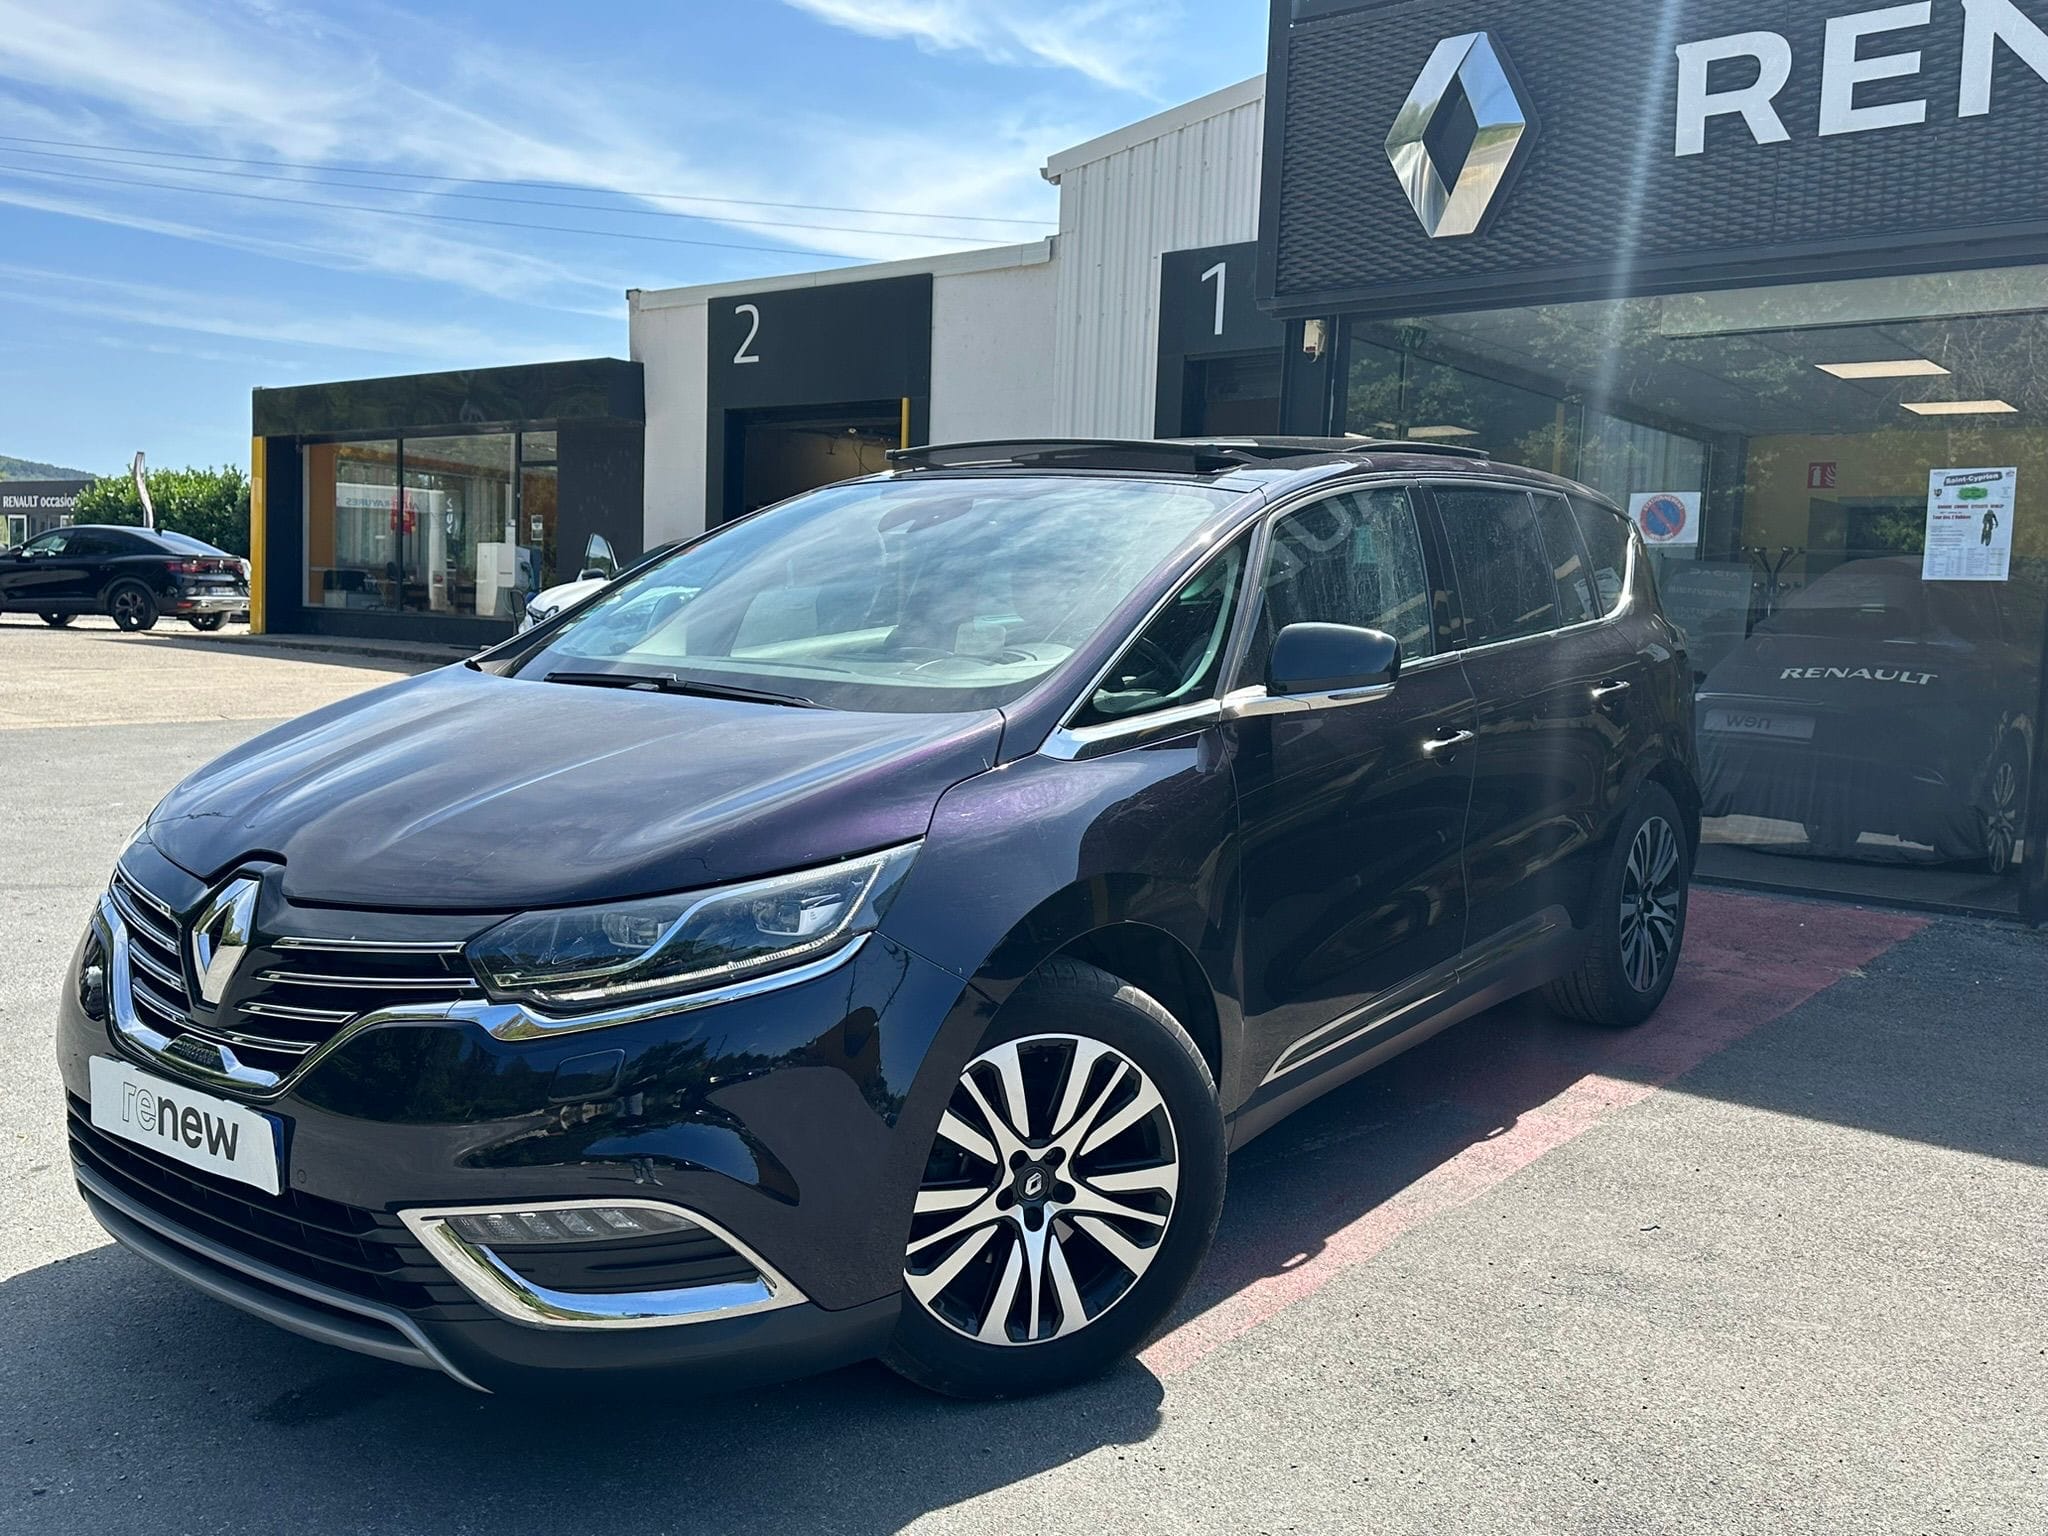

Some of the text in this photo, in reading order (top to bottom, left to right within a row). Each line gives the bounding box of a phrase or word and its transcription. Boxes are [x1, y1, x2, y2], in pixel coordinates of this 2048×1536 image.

[1201, 262, 1227, 336] 1
[733, 304, 760, 364] 2
[3, 495, 39, 508] RENAULT
[1780, 667, 1938, 685] RENAULT
[122, 1081, 239, 1161] renew
